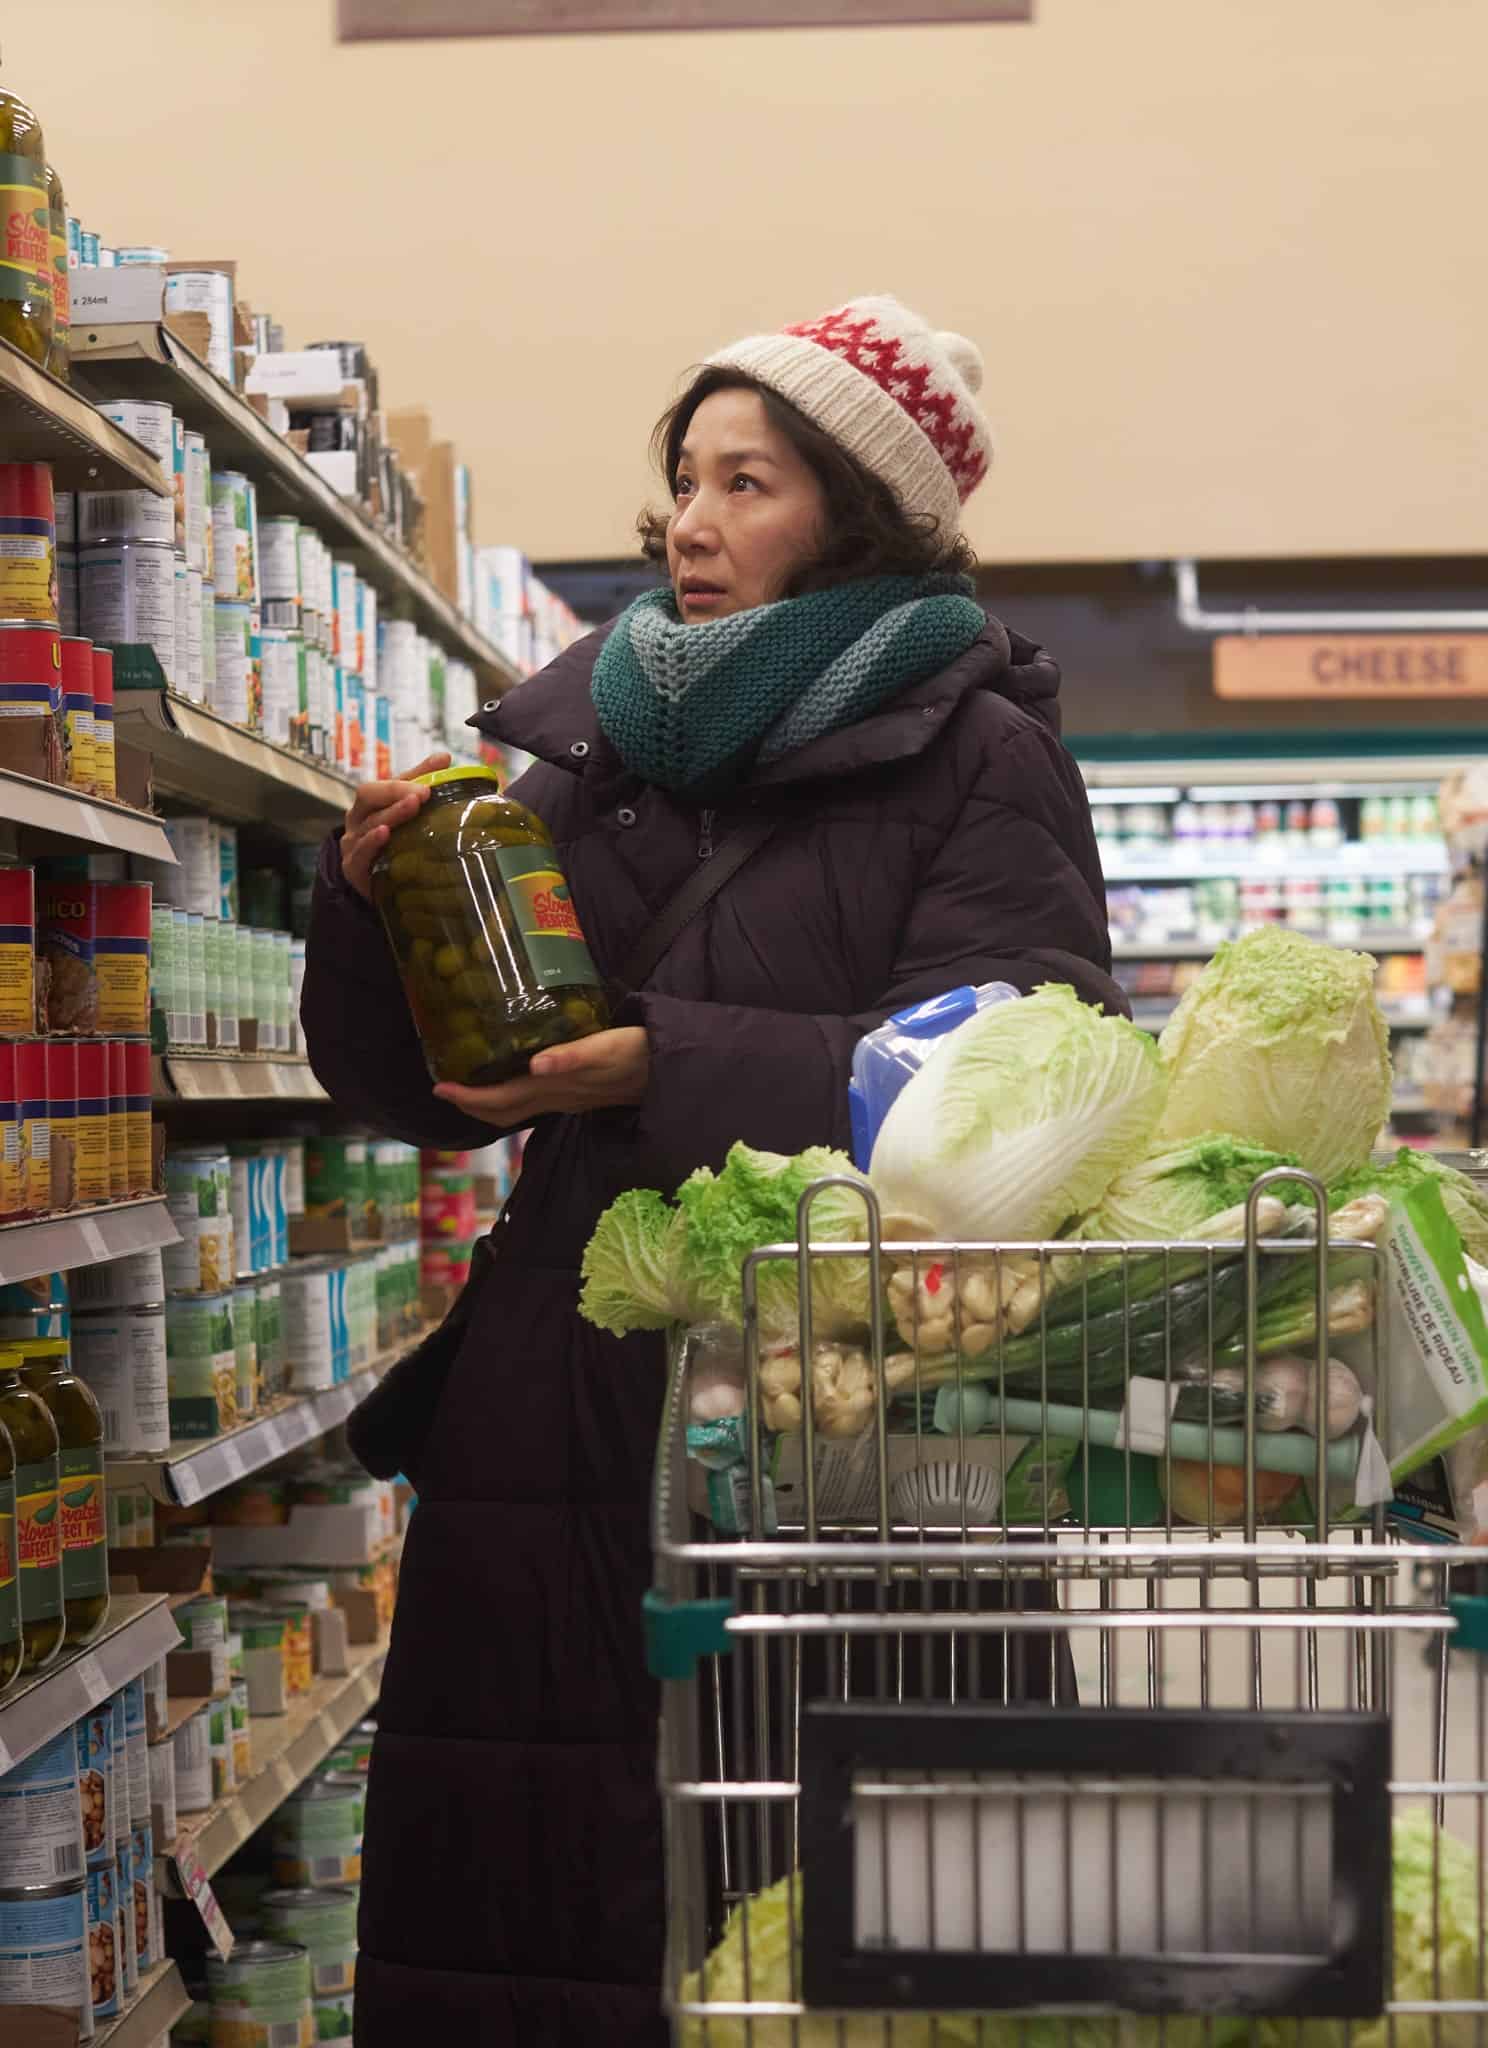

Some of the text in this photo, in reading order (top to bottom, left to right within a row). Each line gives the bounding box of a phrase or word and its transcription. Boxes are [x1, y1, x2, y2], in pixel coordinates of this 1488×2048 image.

[1311, 648, 1468, 684] CHEESE
[1388, 1238, 1465, 1385] DOUBLURE DE RIDEAU
[1397, 1223, 1479, 1385] SHOWER CURTAIN LINER
[1403, 1300, 1433, 1359] DOUCHE
